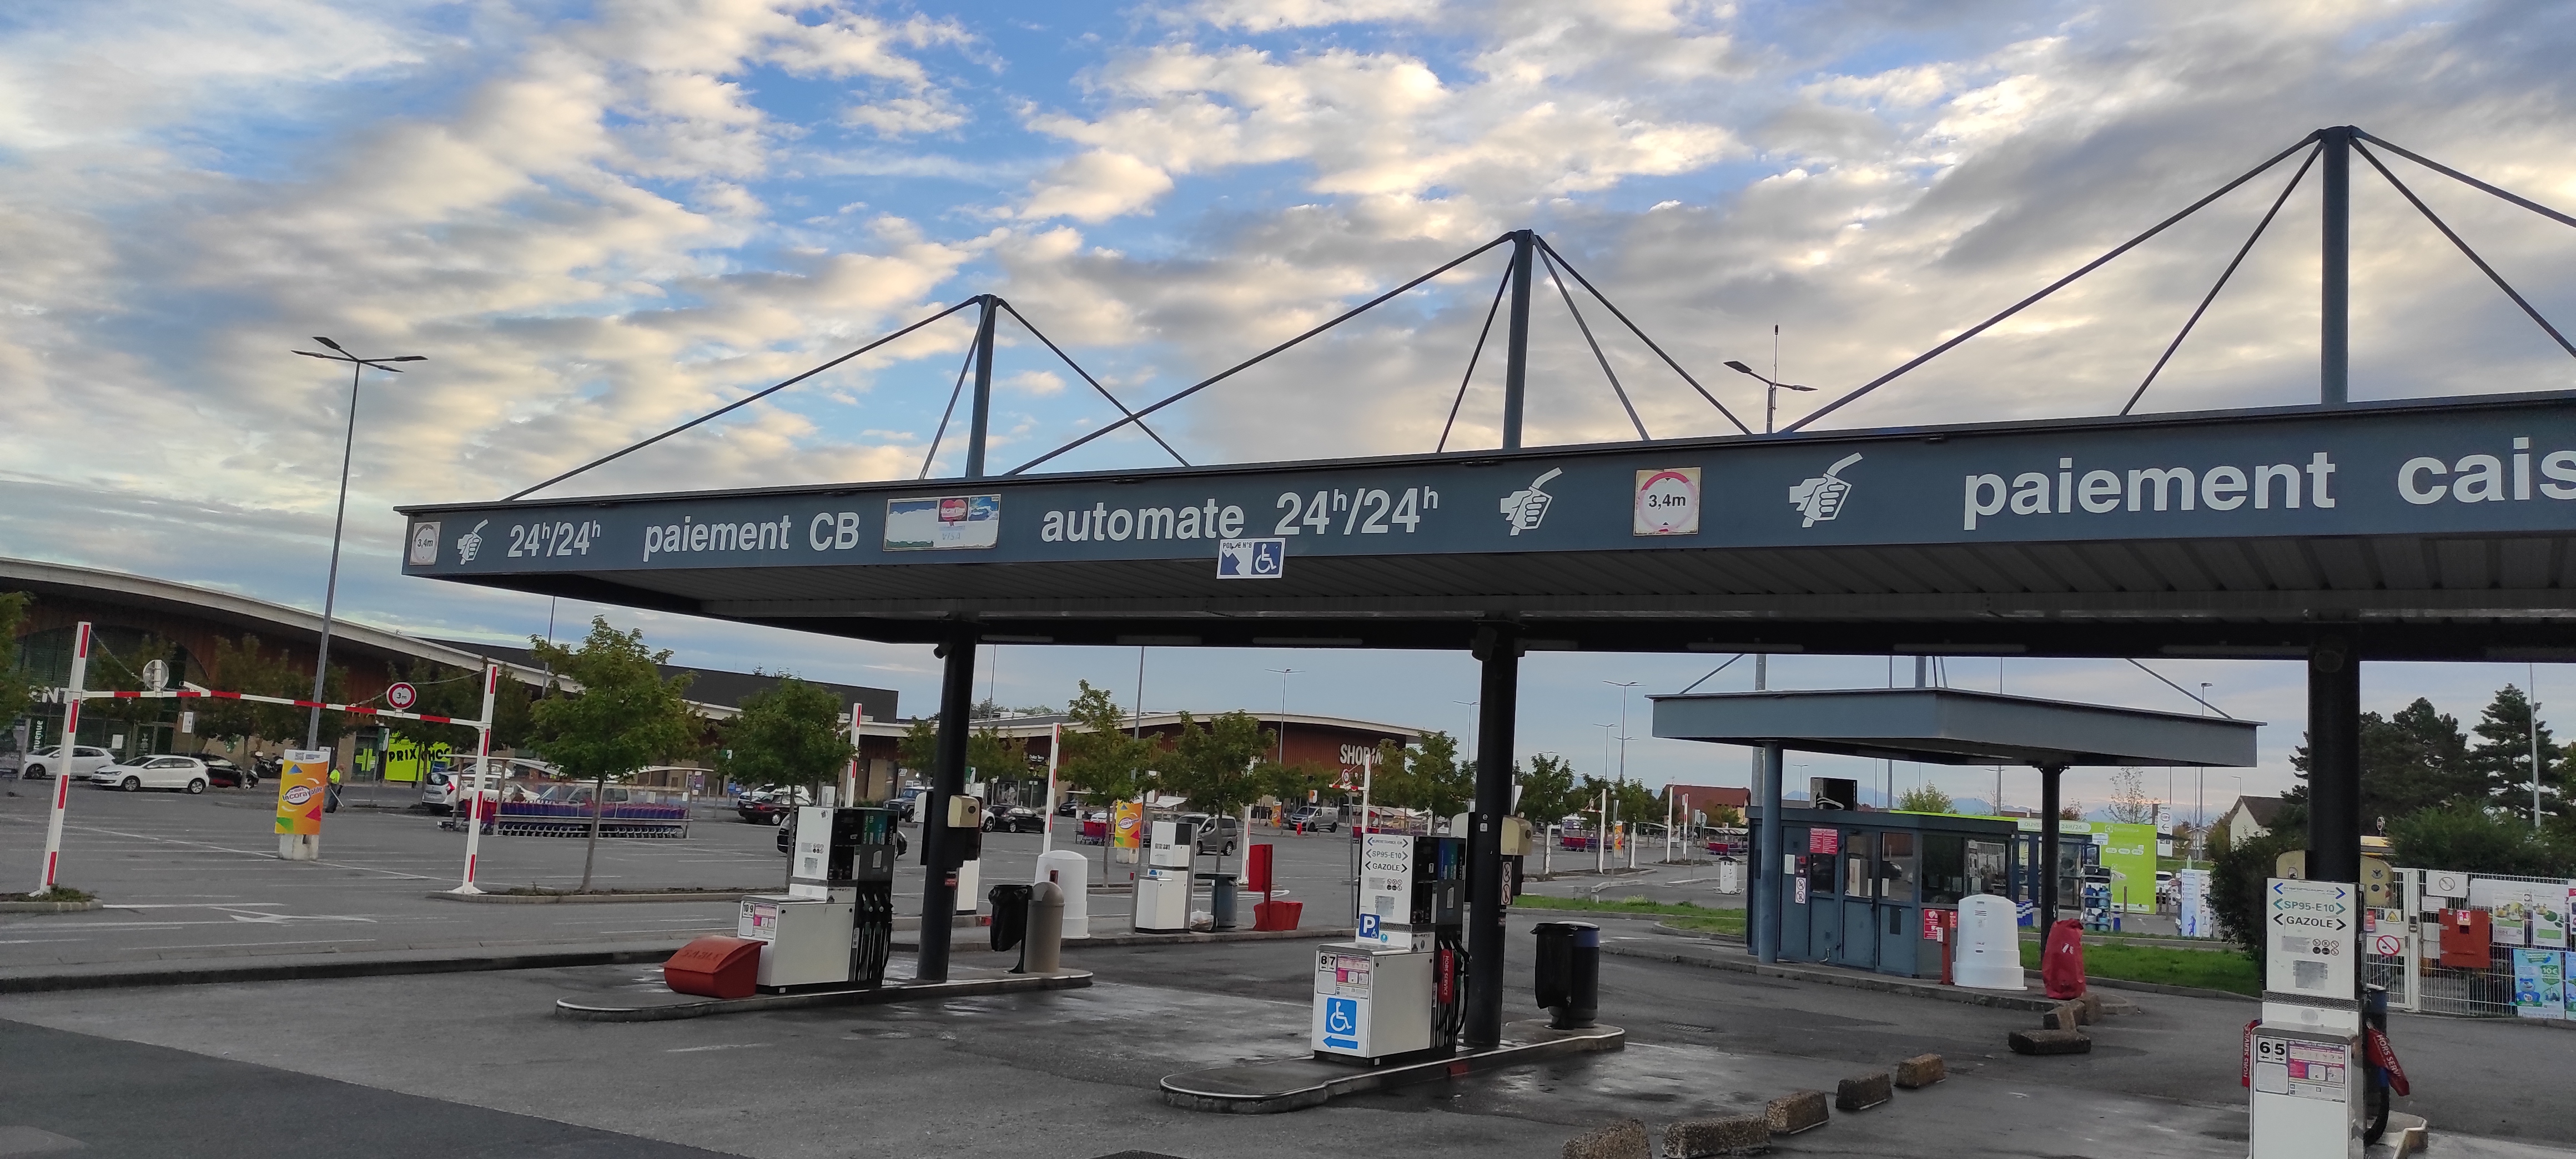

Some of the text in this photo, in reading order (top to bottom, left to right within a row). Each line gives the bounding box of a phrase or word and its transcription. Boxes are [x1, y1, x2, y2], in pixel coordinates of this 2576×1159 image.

[1964, 436, 2576, 531] paiement cais
[1648, 493, 1686, 511] 3,4m
[1041, 497, 1245, 543] automate
[416, 537, 434, 548] 3,4m
[642, 511, 860, 562] paiement CB
[389, 748, 417, 763] PRIX
[1371, 850, 1402, 859] SP95-E10
[1372, 863, 1401, 871] GAZOLE
[743, 904, 749, 913] 10
[749, 905, 753, 913] 9
[2283, 900, 2335, 913] SP95-E10
[1363, 915, 1376, 934] P
[2286, 916, 2333, 928] GAZOLE
[1321, 955, 1327, 965] 8
[1329, 956, 1336, 966] 7
[2259, 1041, 2271, 1054] 6
[2273, 1043, 2285, 1056] 5
[2376, 1034, 2391, 1056] HORS
